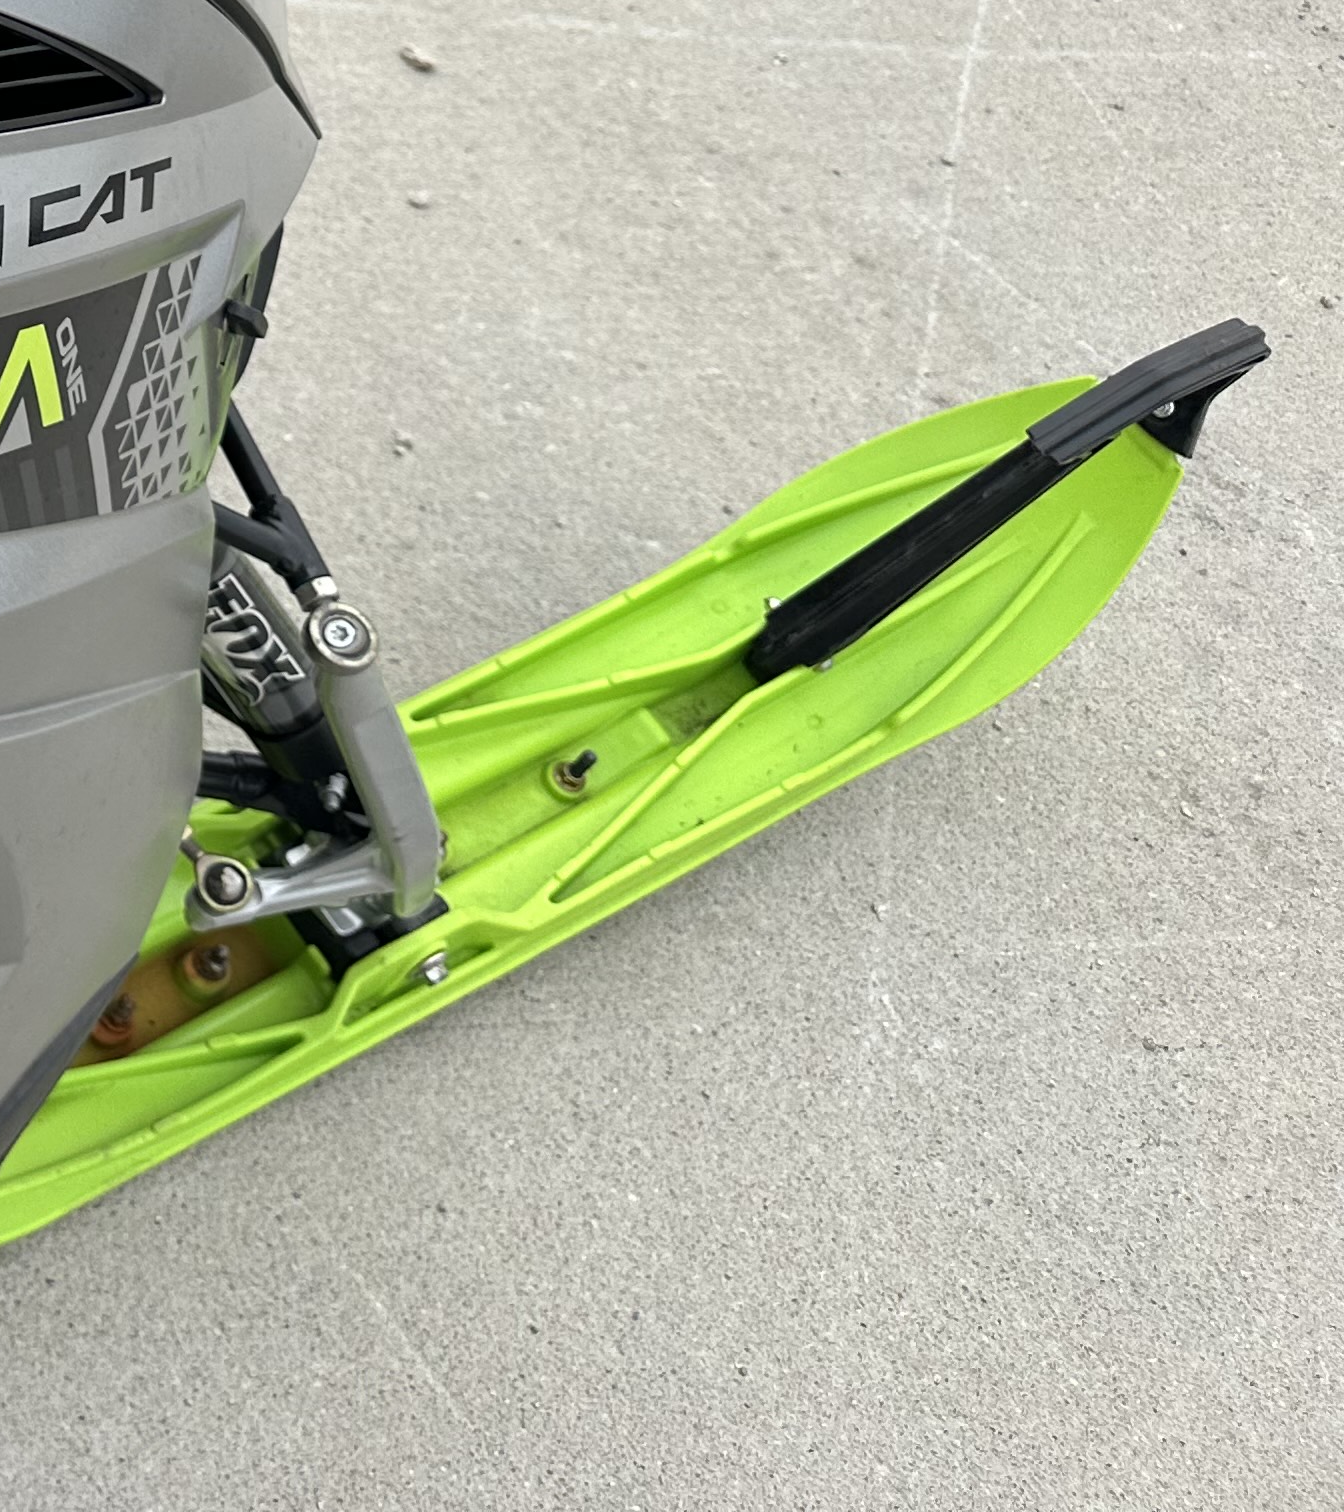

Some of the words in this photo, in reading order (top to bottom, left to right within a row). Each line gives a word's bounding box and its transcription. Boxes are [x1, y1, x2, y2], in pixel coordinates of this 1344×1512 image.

[29, 157, 172, 247] CAT
[56, 315, 86, 416] ONE
[205, 573, 306, 706] FOX
